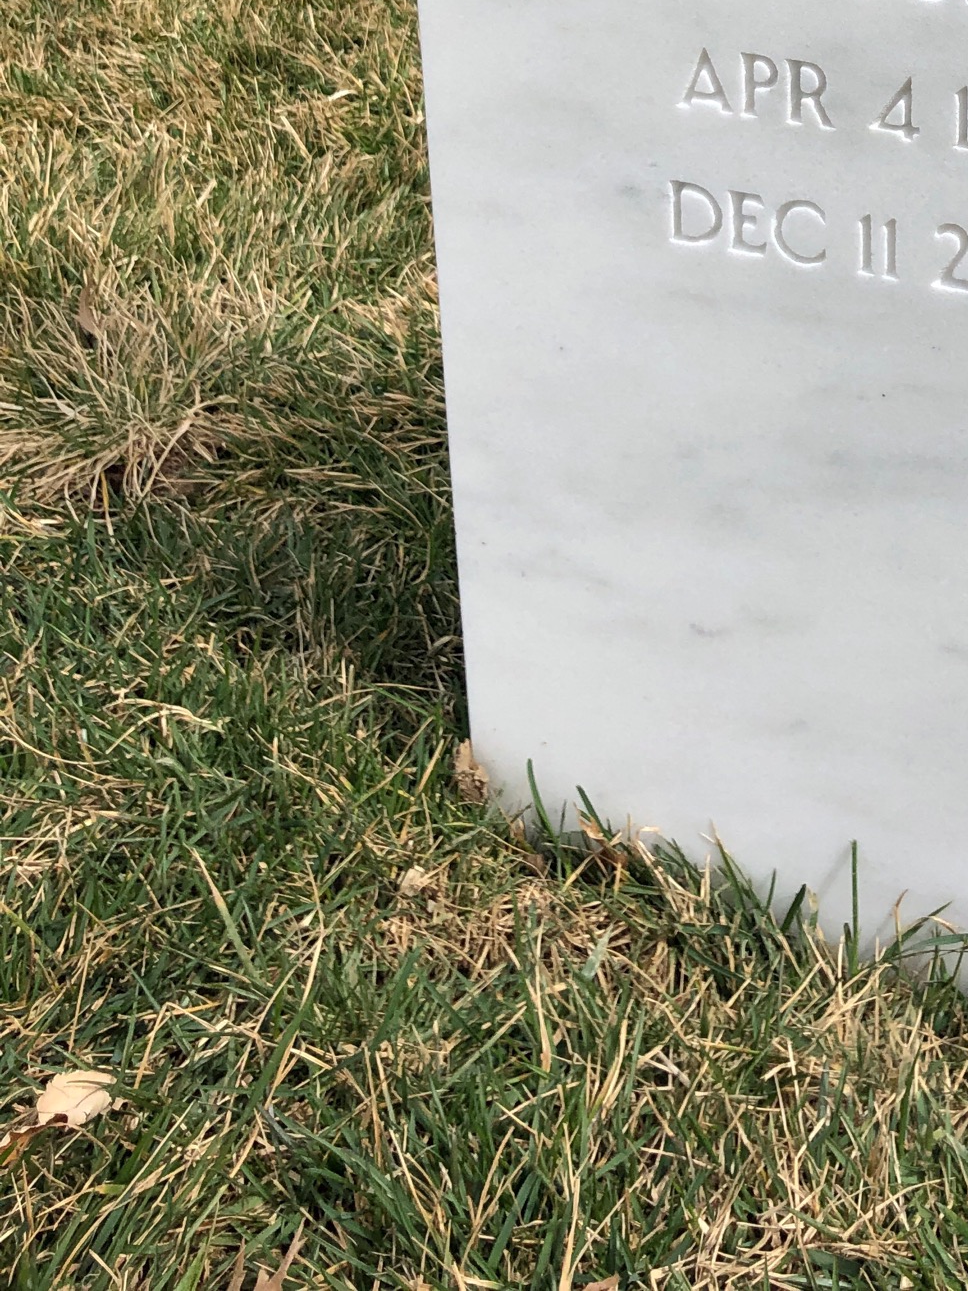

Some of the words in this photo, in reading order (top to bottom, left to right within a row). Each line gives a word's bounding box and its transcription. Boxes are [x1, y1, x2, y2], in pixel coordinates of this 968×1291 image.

[676, 47, 836, 130] APR
[869, 76, 920, 141] 4
[669, 179, 826, 266] DEC
[857, 214, 898, 281] 11
